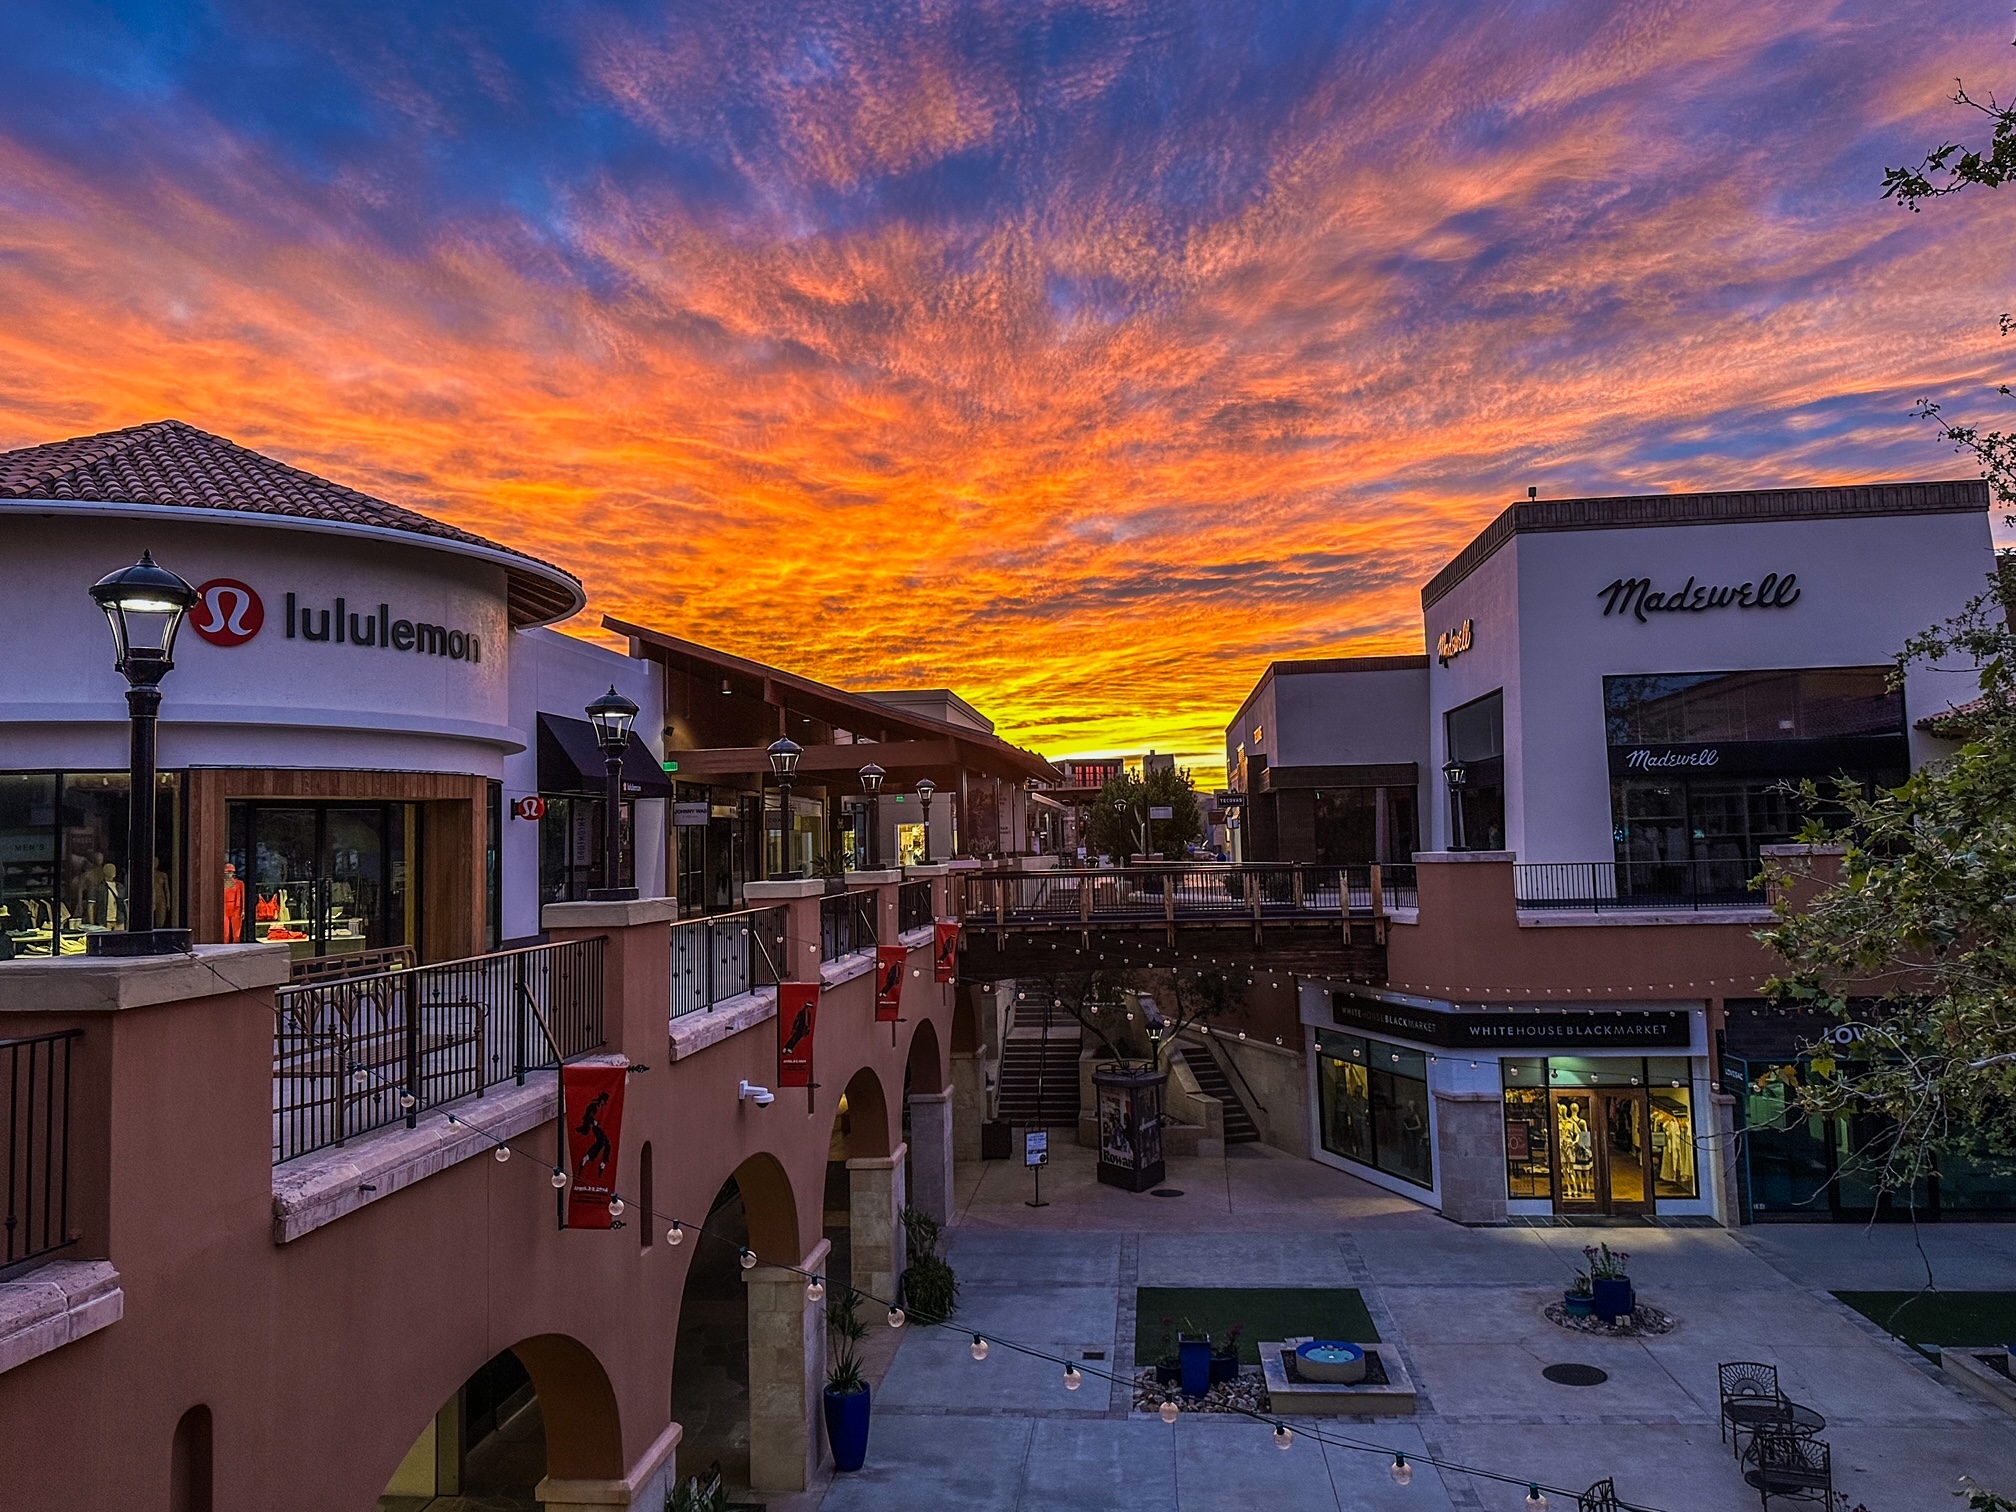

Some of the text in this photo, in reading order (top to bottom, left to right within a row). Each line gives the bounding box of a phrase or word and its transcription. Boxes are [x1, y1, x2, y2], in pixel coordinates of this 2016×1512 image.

[1598, 572, 1801, 623] Madewell
[285, 591, 482, 664] lululemon
[1626, 749, 1719, 771] Madewell
[14, 843, 45, 852] MEN'S
